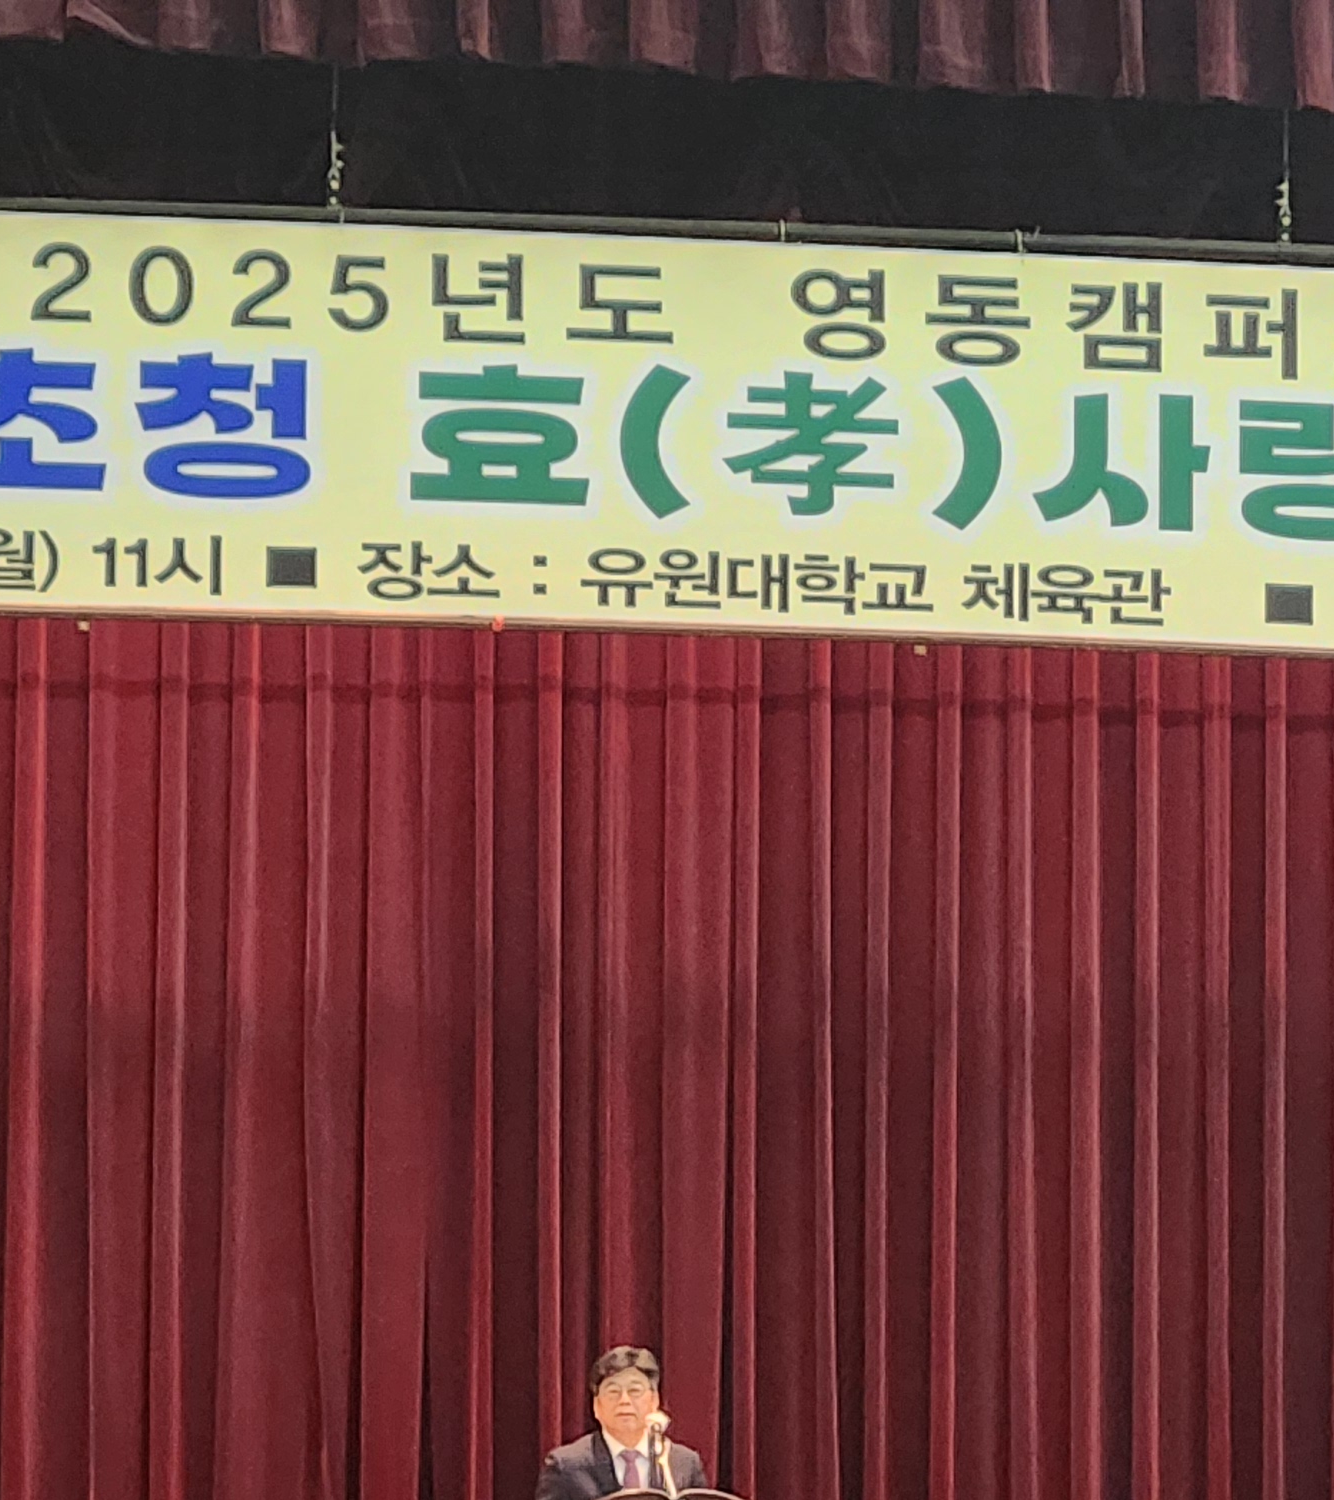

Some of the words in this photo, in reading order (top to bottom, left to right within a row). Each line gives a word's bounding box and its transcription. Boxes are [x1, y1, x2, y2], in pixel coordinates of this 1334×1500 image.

[31, 241, 675, 345] 2025년도
[91, 534, 224, 597] 11시
[356, 540, 501, 600] 장소
[579, 547, 935, 617] 유원대학교
[961, 562, 1173, 627] 체육관
